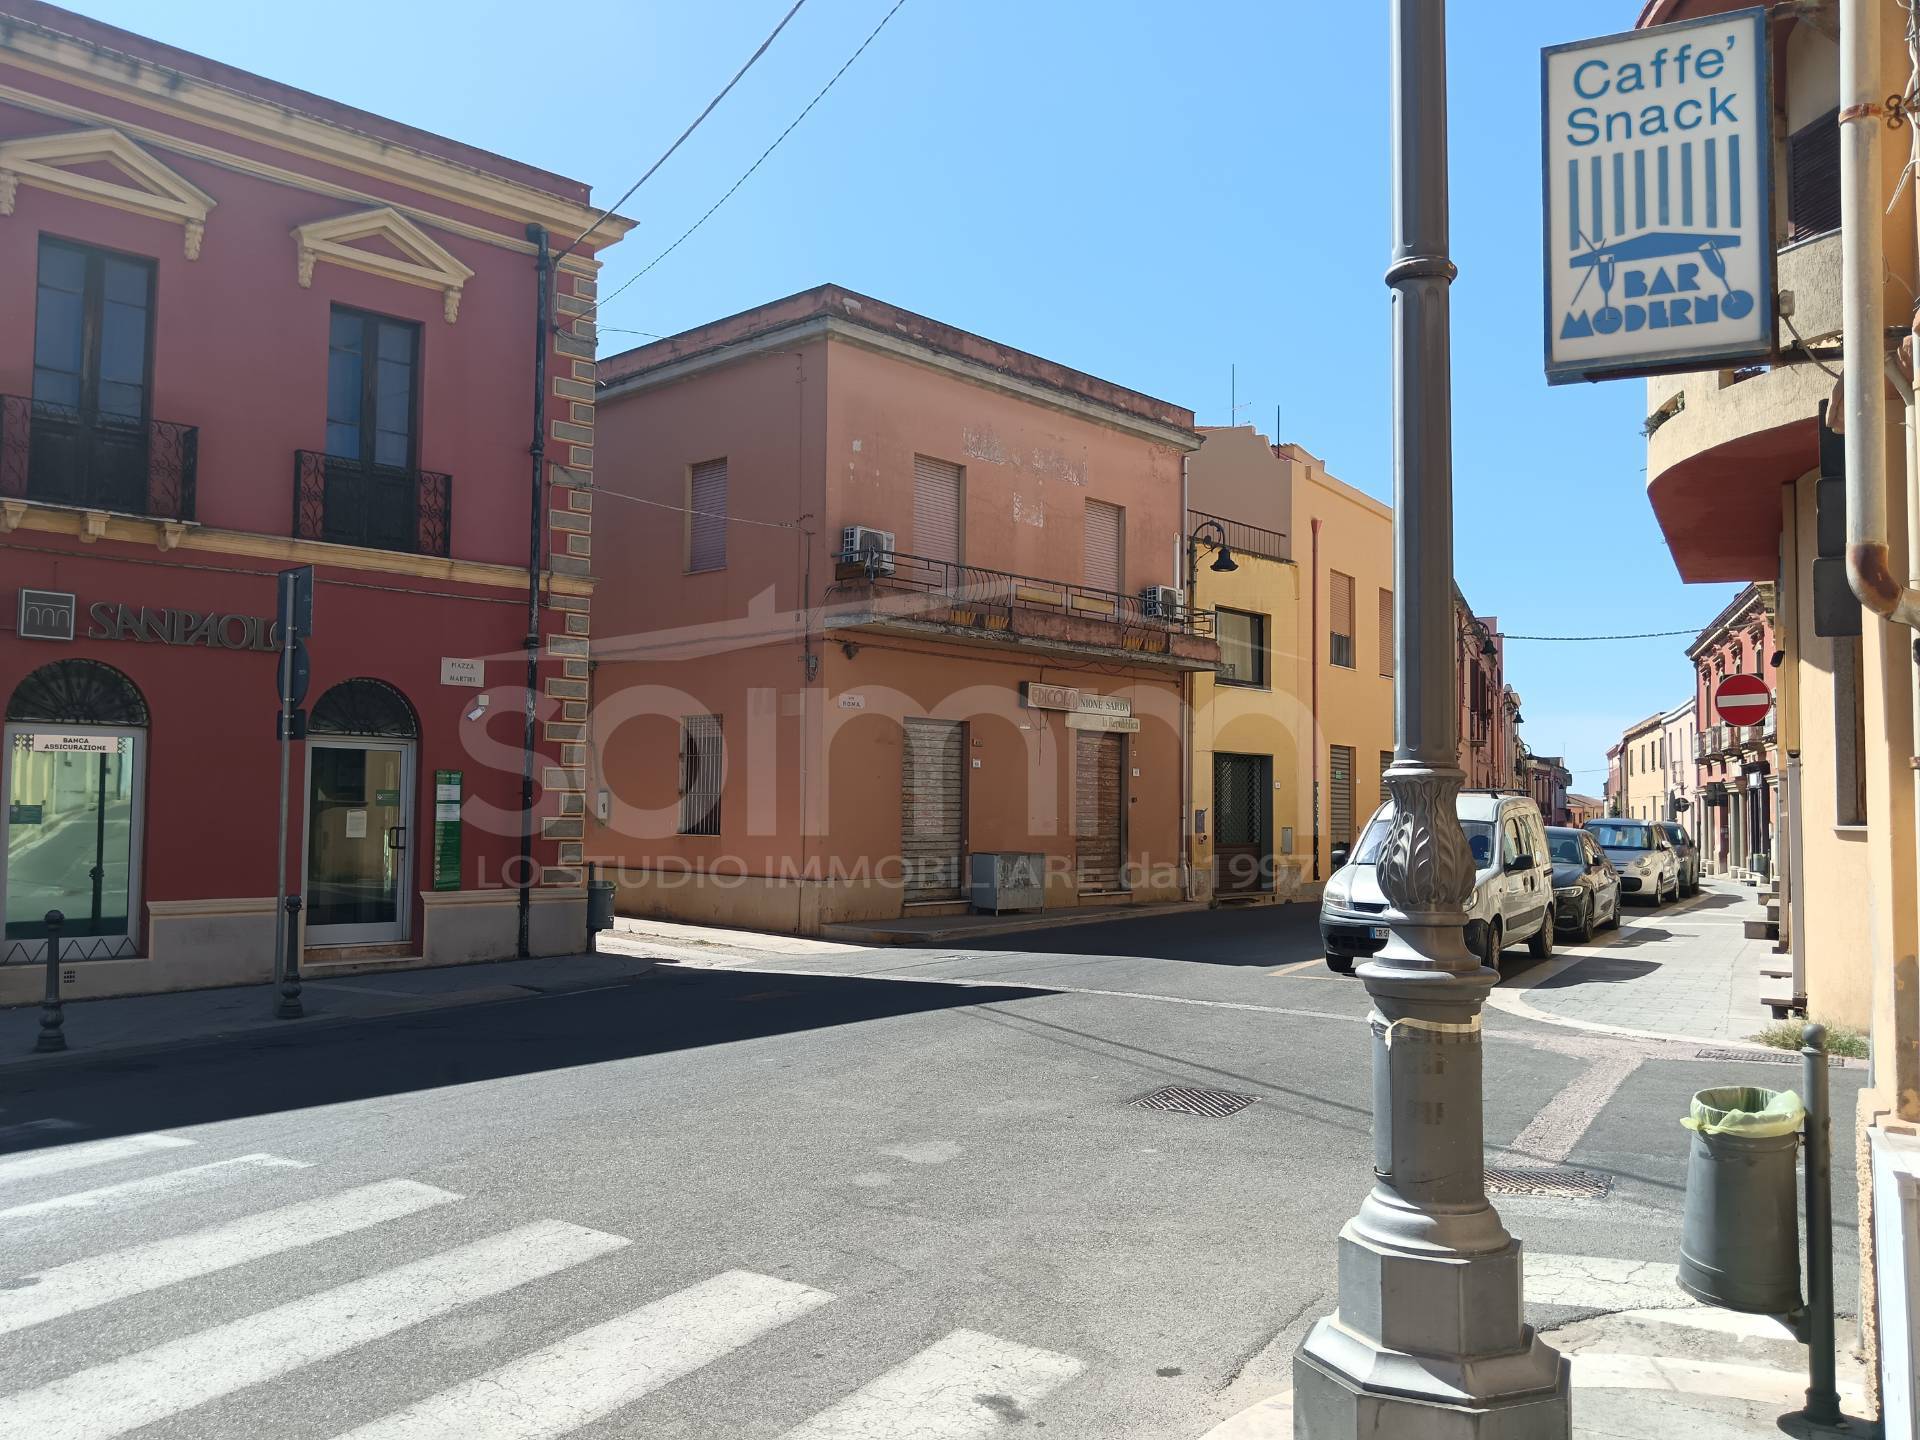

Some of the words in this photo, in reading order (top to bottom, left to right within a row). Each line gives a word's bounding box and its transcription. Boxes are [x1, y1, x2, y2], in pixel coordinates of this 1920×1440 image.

[1573, 35, 1736, 100] Caffe'
[1567, 87, 1739, 146] Snack
[1624, 263, 1701, 299] BAR
[1559, 290, 1755, 340] MODERNO
[451, 662, 474, 670] PIAZZA
[449, 675, 476, 683] MARTIRI
[1105, 702, 1130, 713] SARDA
[1109, 718, 1139, 731] Repubblica
